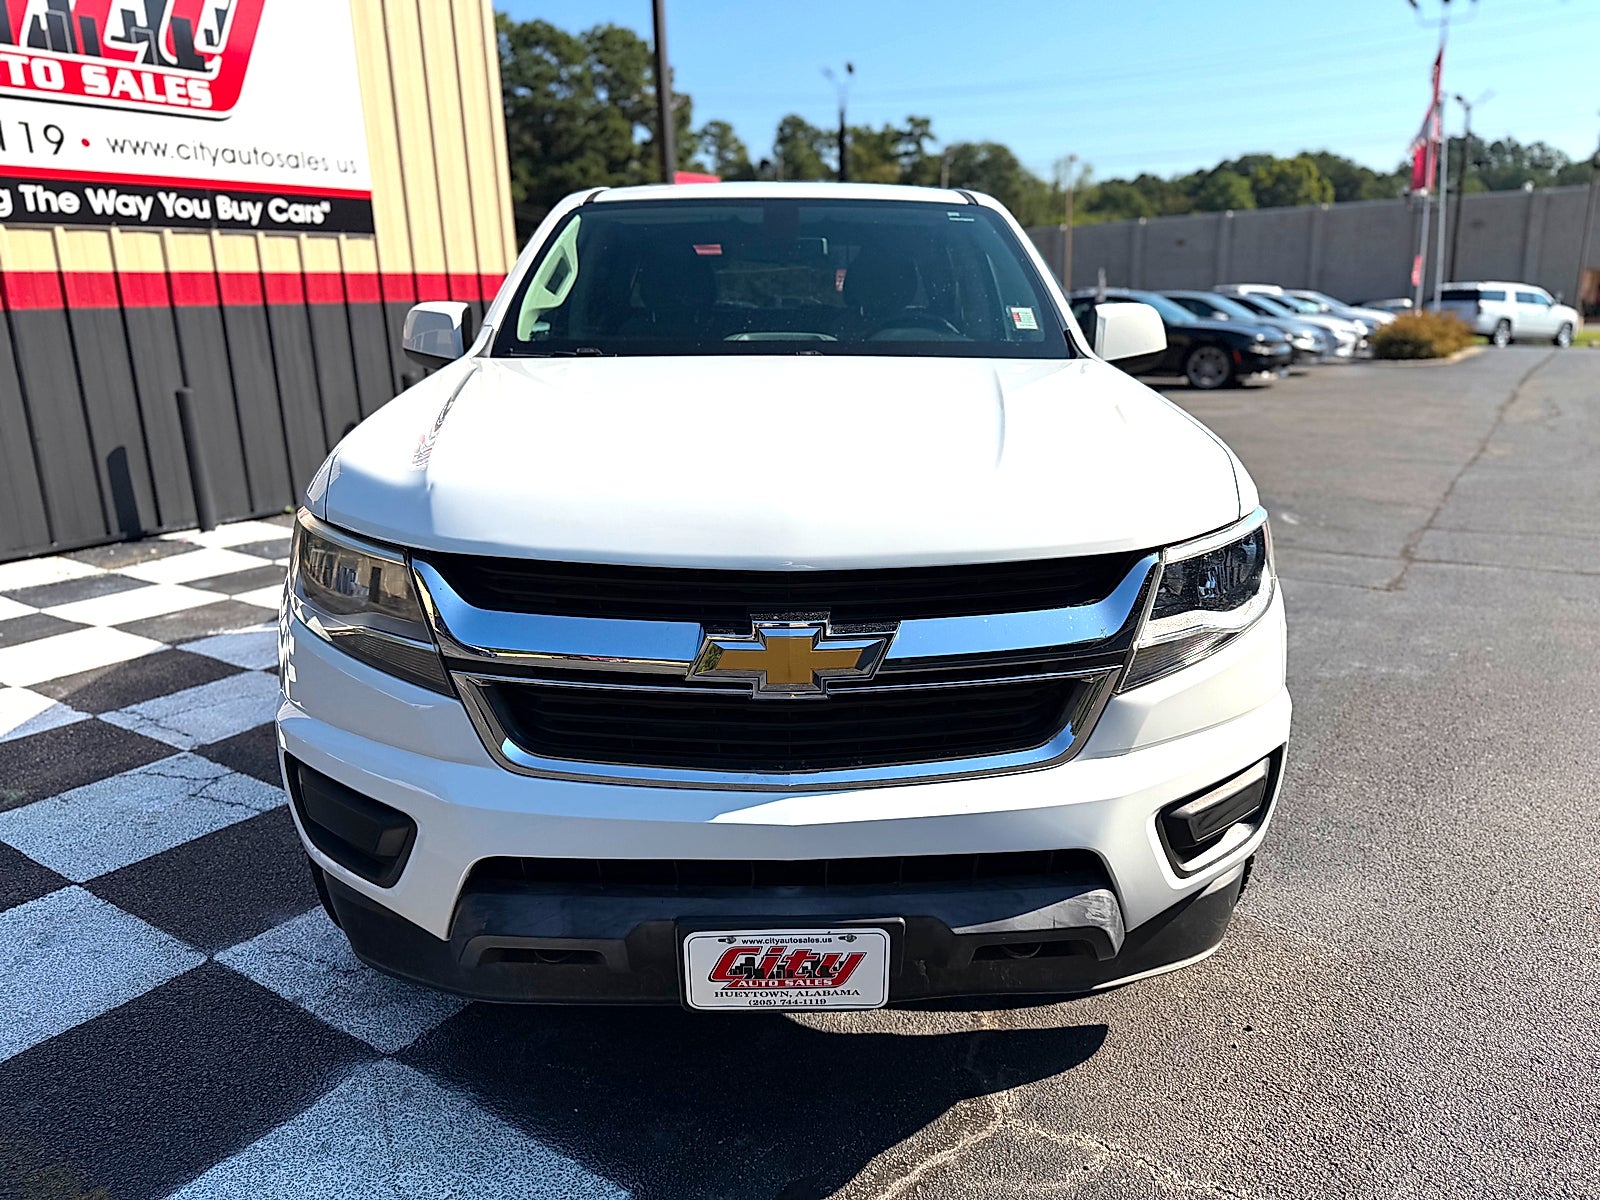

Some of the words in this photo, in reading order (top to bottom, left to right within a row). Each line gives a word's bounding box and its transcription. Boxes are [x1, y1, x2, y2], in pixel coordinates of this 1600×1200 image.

[81, 64, 213, 108] SALES
[18, 184, 80, 214] The
[84, 187, 153, 222] Way
[157, 191, 212, 220] You
[215, 194, 262, 227] Buy
[741, 936, 832, 946] www.cityautosales.us
[707, 945, 867, 987] City
[737, 979, 779, 987] AUTO
[785, 978, 833, 987] SALES
[714, 990, 793, 998] HUEYTOWN,
[795, 989, 861, 997] ALABAMA
[749, 998, 777, 1006] (205)
